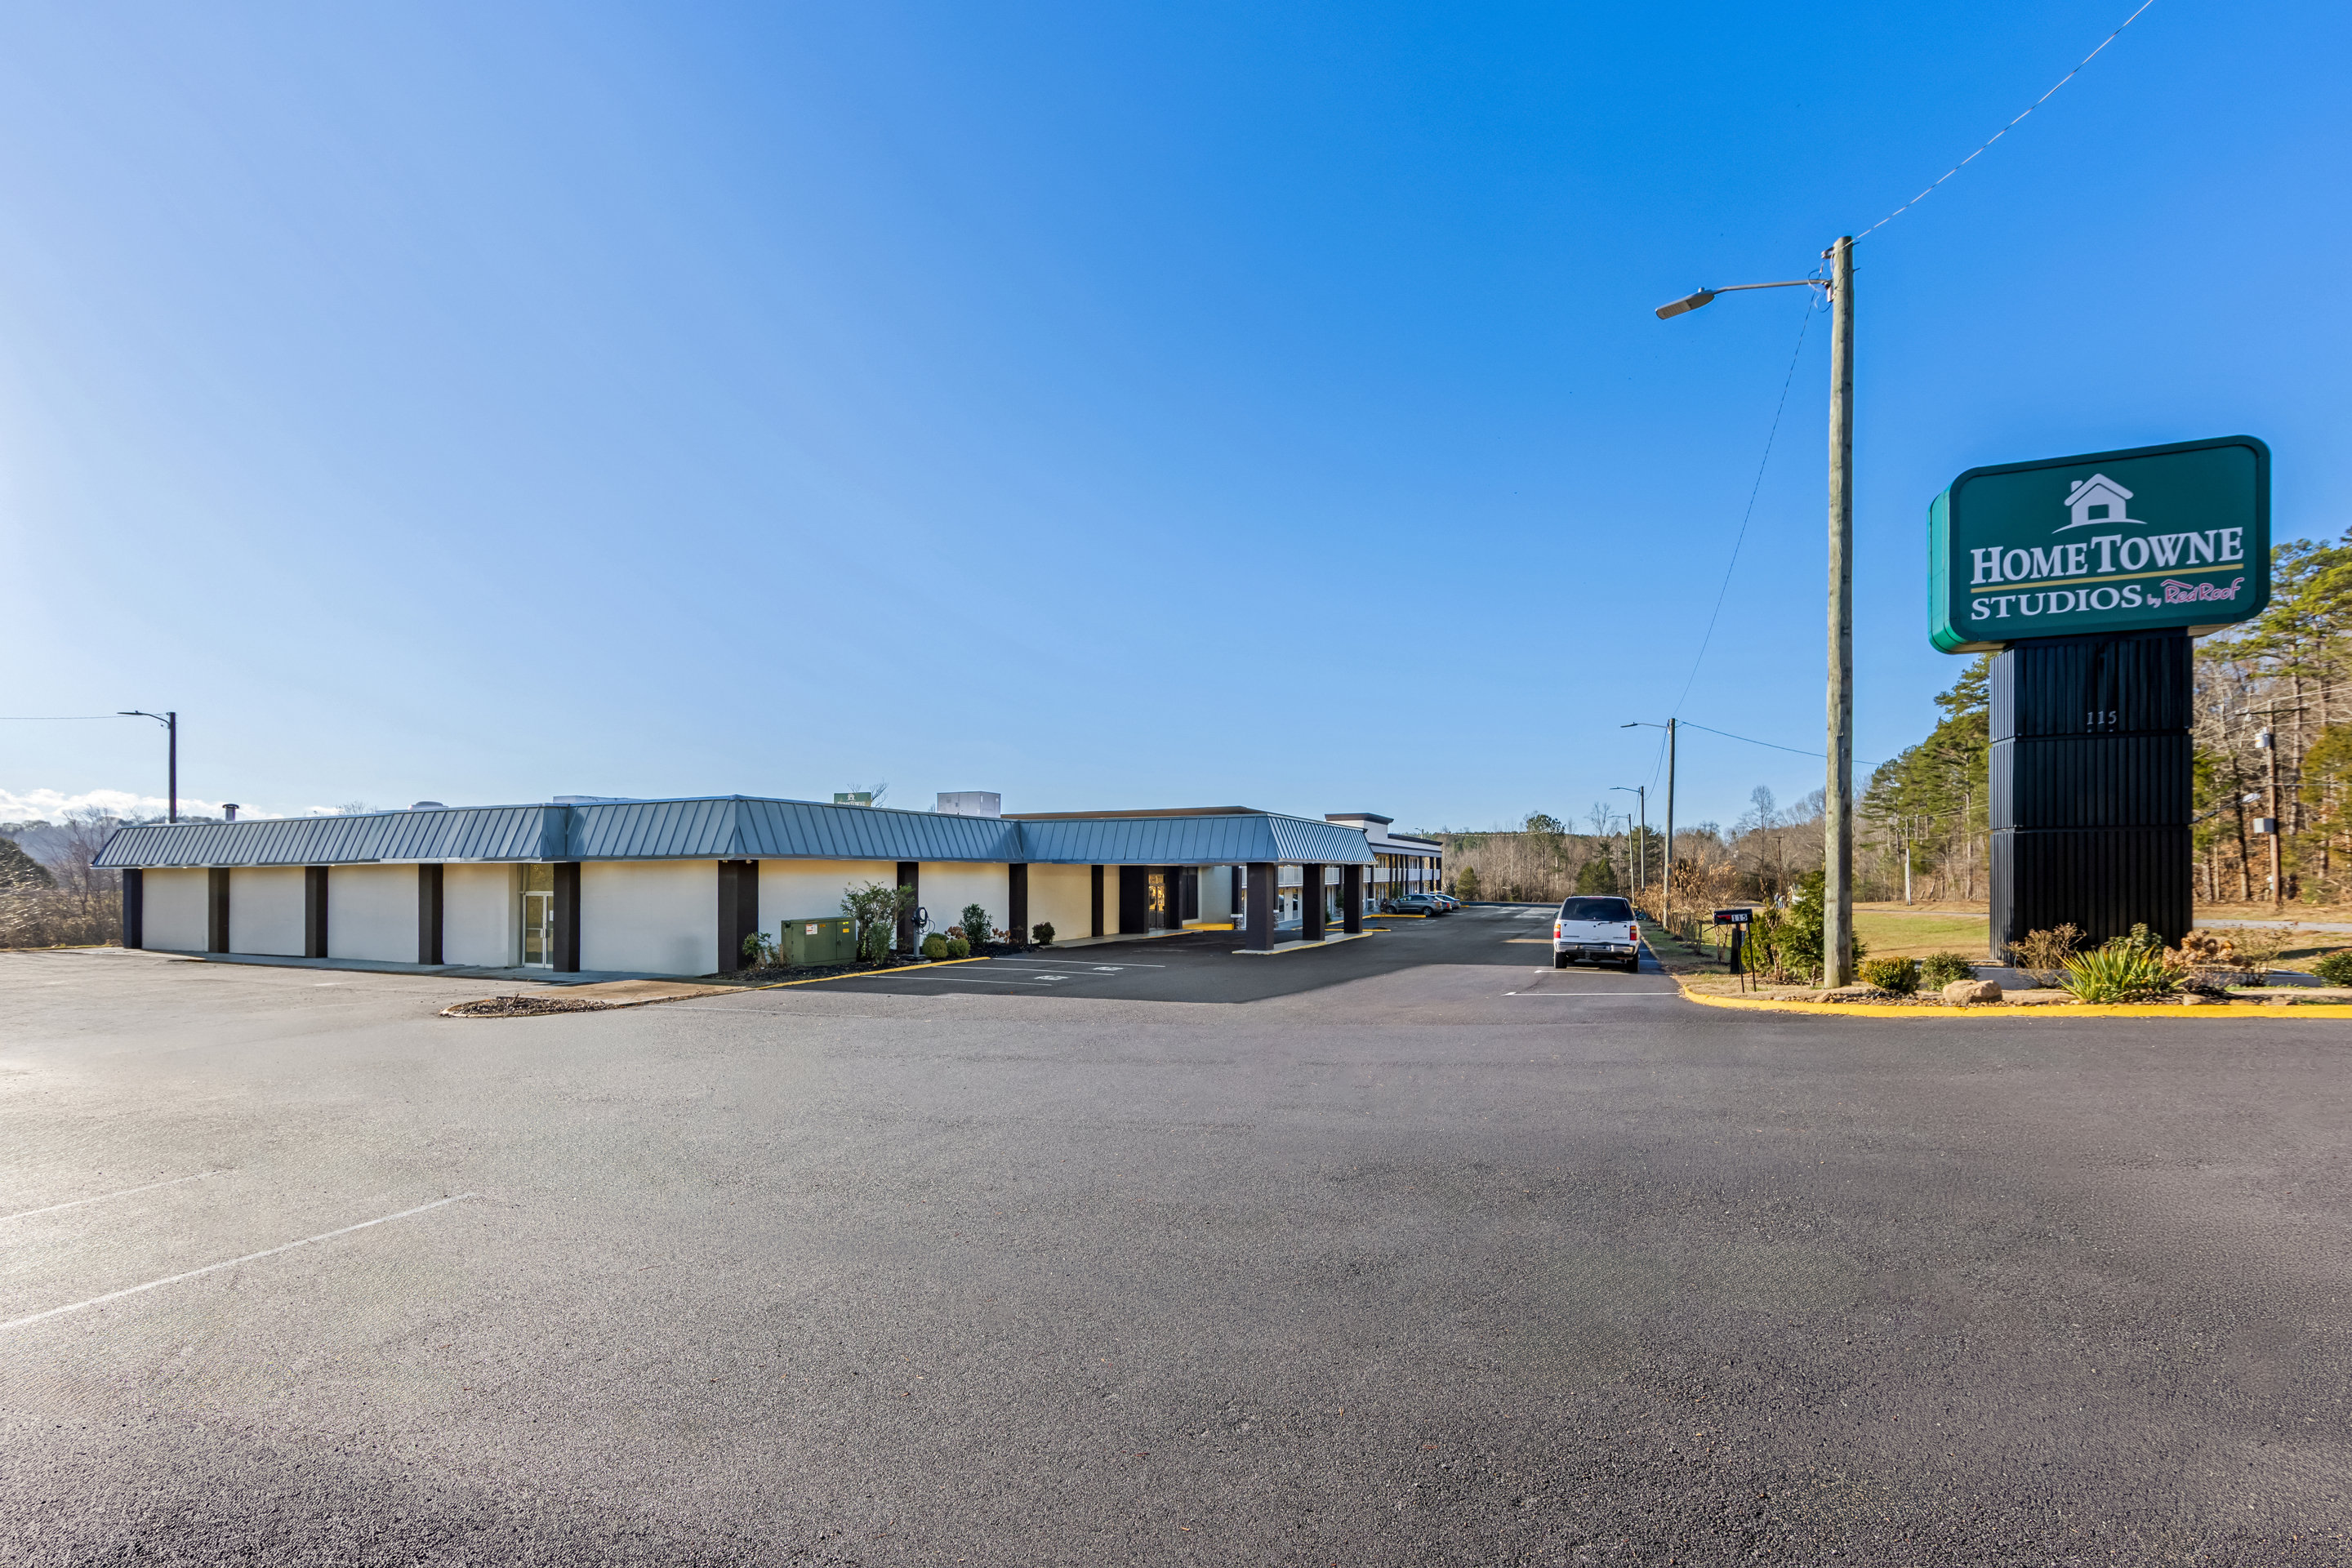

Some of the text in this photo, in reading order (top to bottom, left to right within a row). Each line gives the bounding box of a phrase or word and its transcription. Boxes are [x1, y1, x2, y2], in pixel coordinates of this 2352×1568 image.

[1971, 585, 2142, 621] STUDIOS
[2147, 594, 2162, 608] by
[2087, 710, 2117, 725] 115
[1732, 914, 1747, 922] 115
